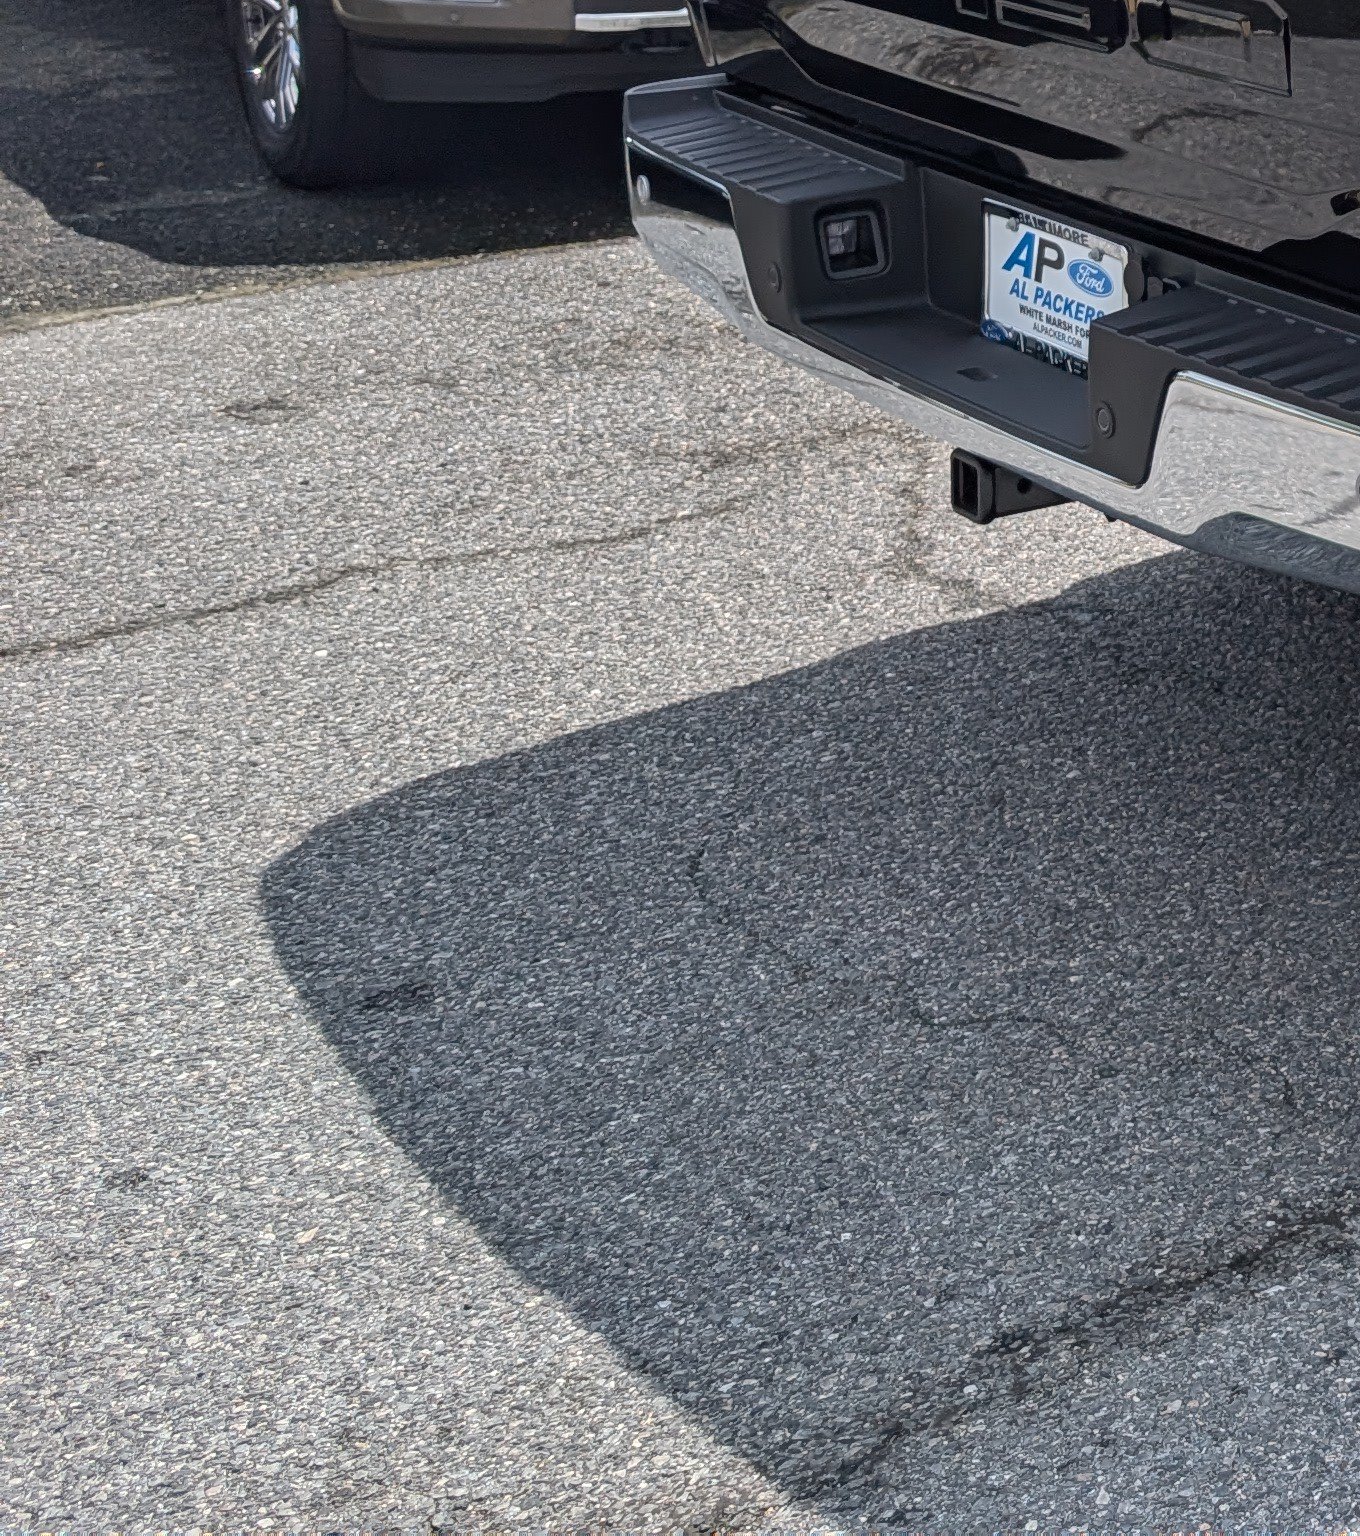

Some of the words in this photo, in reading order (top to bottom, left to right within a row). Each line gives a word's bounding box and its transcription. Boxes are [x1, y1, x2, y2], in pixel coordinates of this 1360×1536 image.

[1001, 231, 1065, 284] AP
[1009, 278, 1029, 301] AL
[1075, 266, 1106, 293] Ford
[1019, 303, 1044, 322] WHITE
[1045, 313, 1073, 333] MARSH
[1074, 325, 1090, 339] FOR
[1032, 322, 1083, 349] ALPACKER.COM
